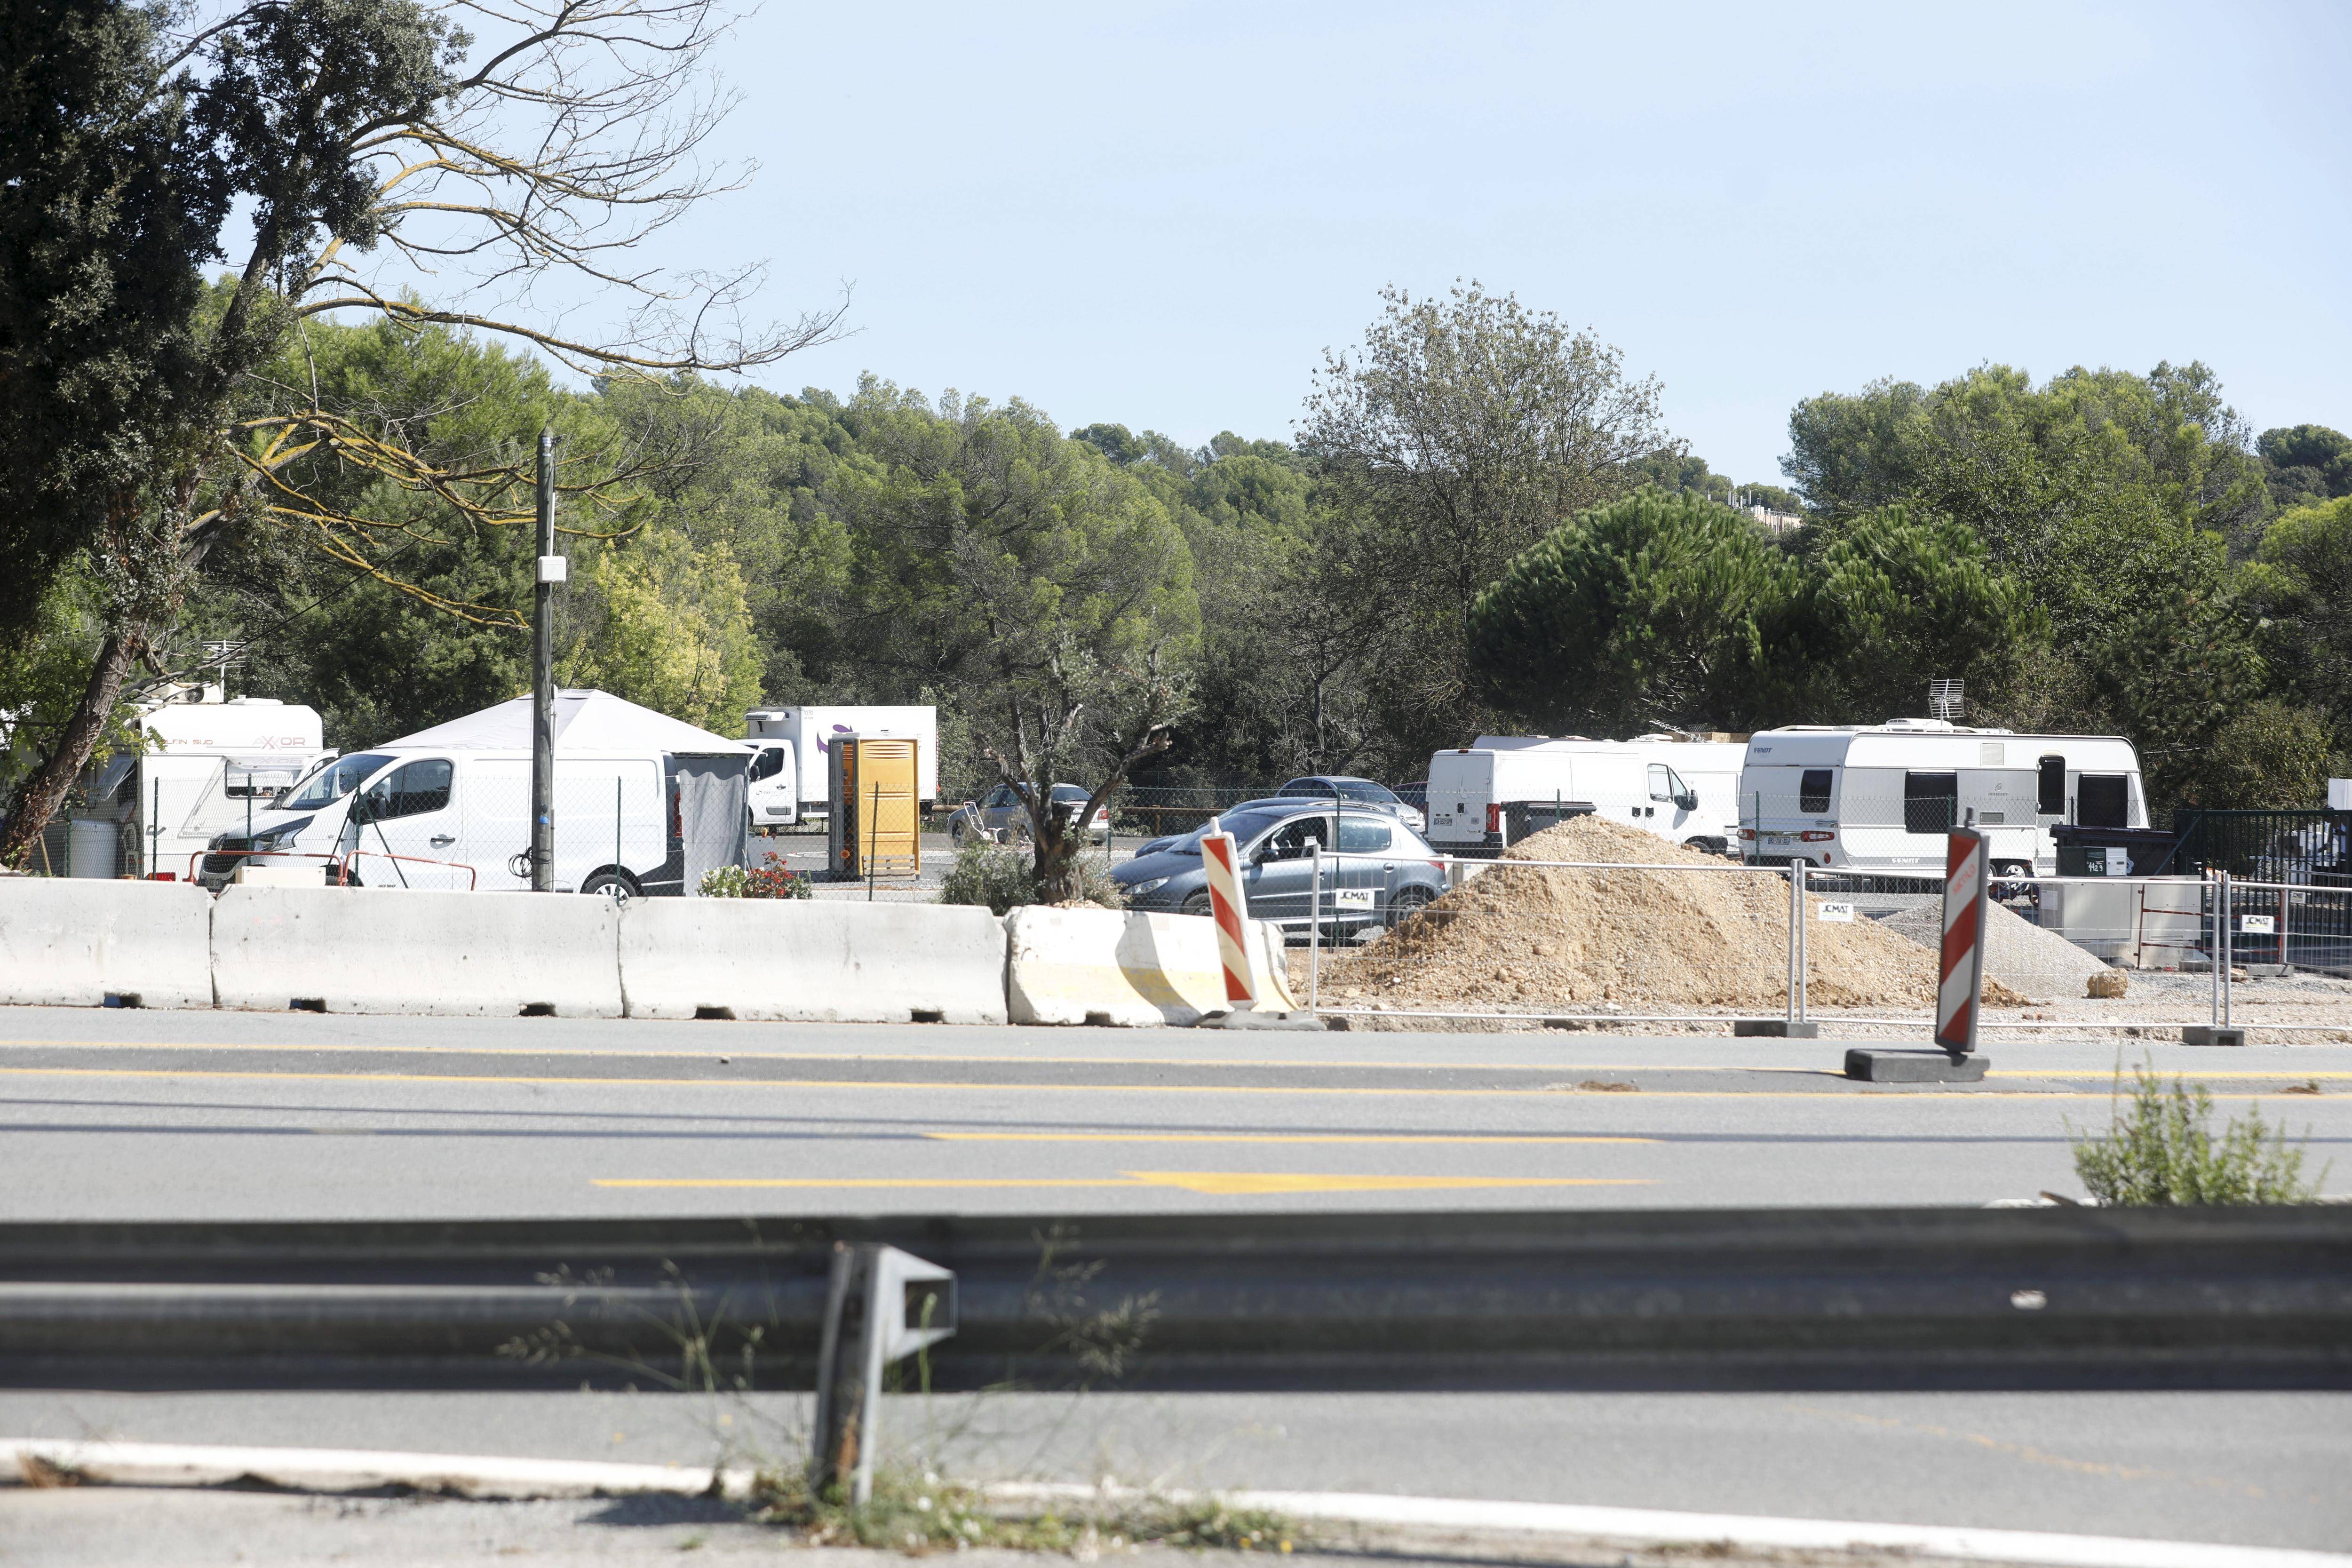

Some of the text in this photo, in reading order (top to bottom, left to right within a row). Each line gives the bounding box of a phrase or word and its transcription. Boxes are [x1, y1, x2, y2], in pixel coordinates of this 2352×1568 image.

[252, 736, 305, 750] AXXOR
[1340, 891, 1369, 900] JCMAT
[1822, 905, 1849, 913] JCMAT
[2245, 916, 2269, 925] JCMAT
